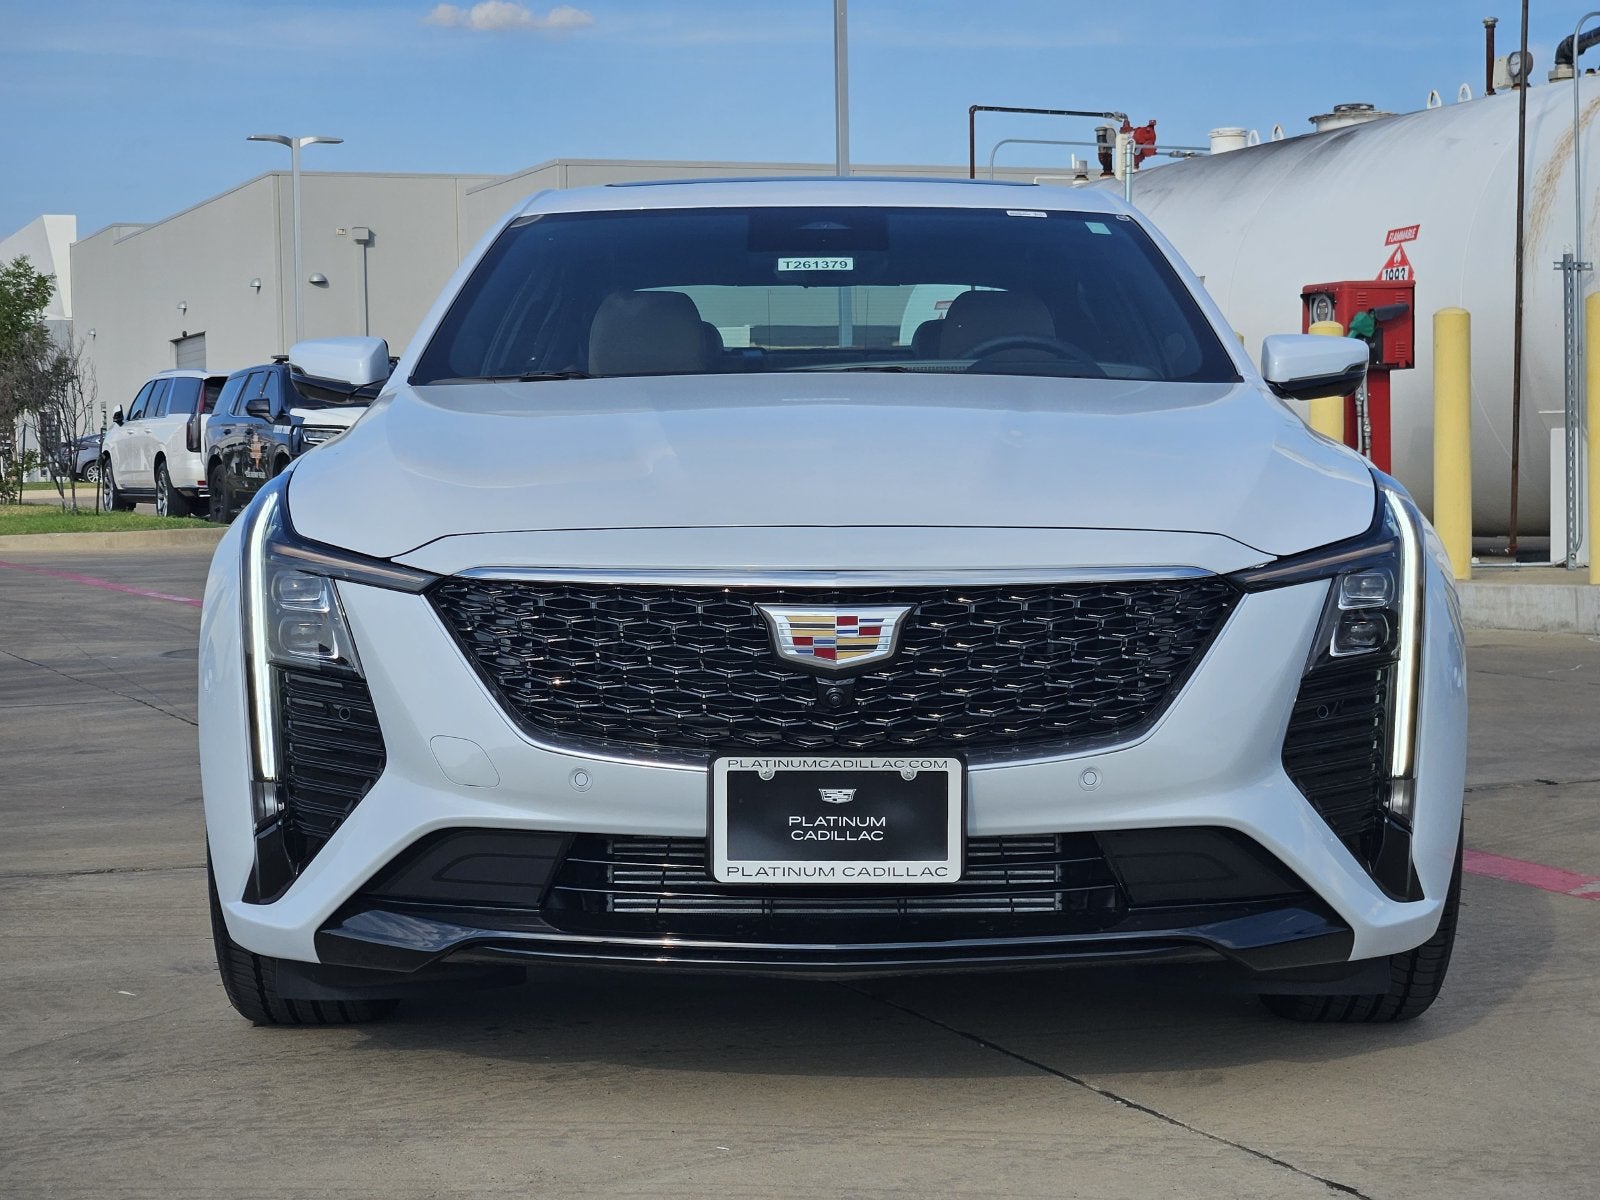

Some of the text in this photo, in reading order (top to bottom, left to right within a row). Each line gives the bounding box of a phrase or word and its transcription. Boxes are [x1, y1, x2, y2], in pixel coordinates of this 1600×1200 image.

[783, 260, 848, 269] T261379
[727, 759, 948, 769] PLATINUMCADILLAC.COM
[788, 816, 886, 827] PLATINUM
[791, 830, 884, 841] CADILLAC
[726, 866, 948, 877] PLATINUM CADILLAC
